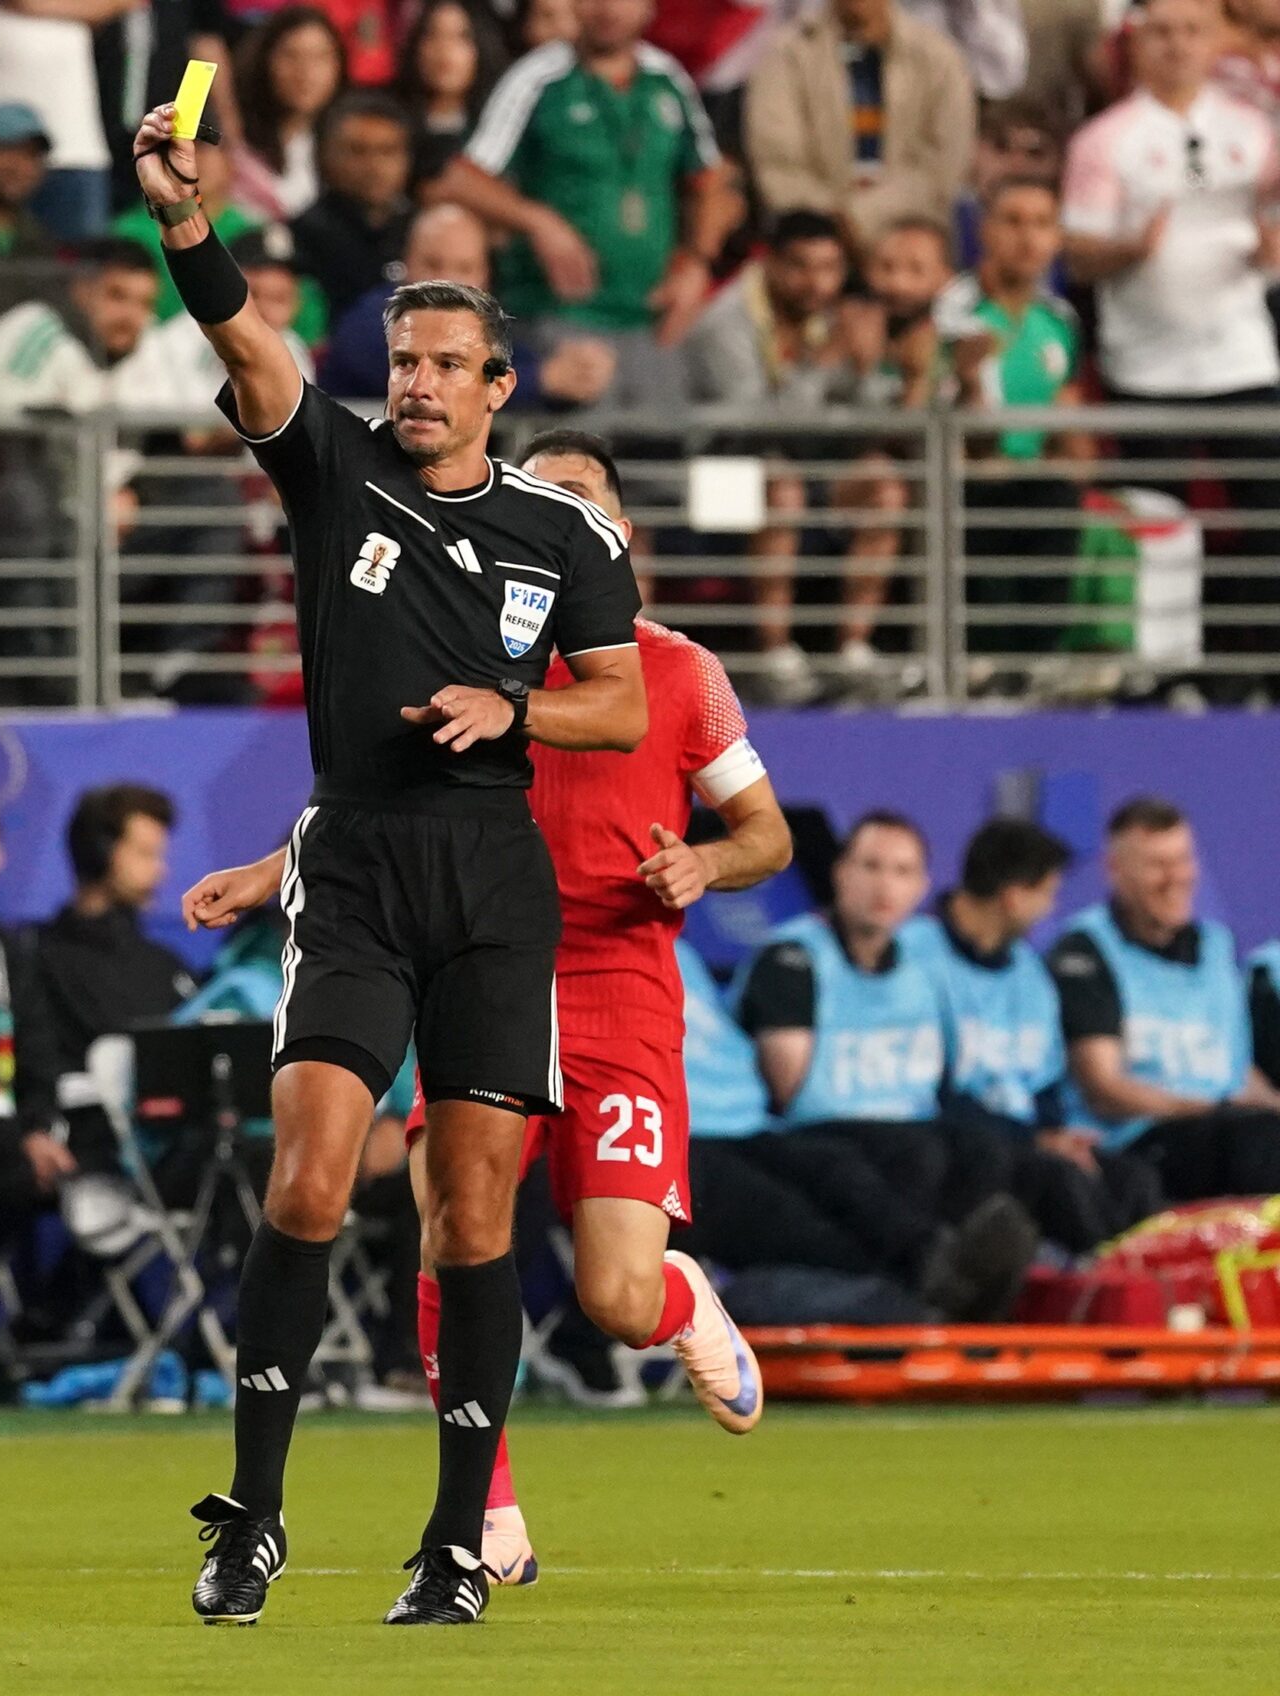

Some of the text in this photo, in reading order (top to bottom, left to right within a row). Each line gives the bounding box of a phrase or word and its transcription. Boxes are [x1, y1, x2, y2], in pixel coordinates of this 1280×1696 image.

[360, 576, 376, 587] FIFA
[511, 586, 548, 612] FIFA
[505, 613, 540, 632] REFEREE
[508, 640, 526, 652] 2026
[597, 1093, 663, 1168] 23
